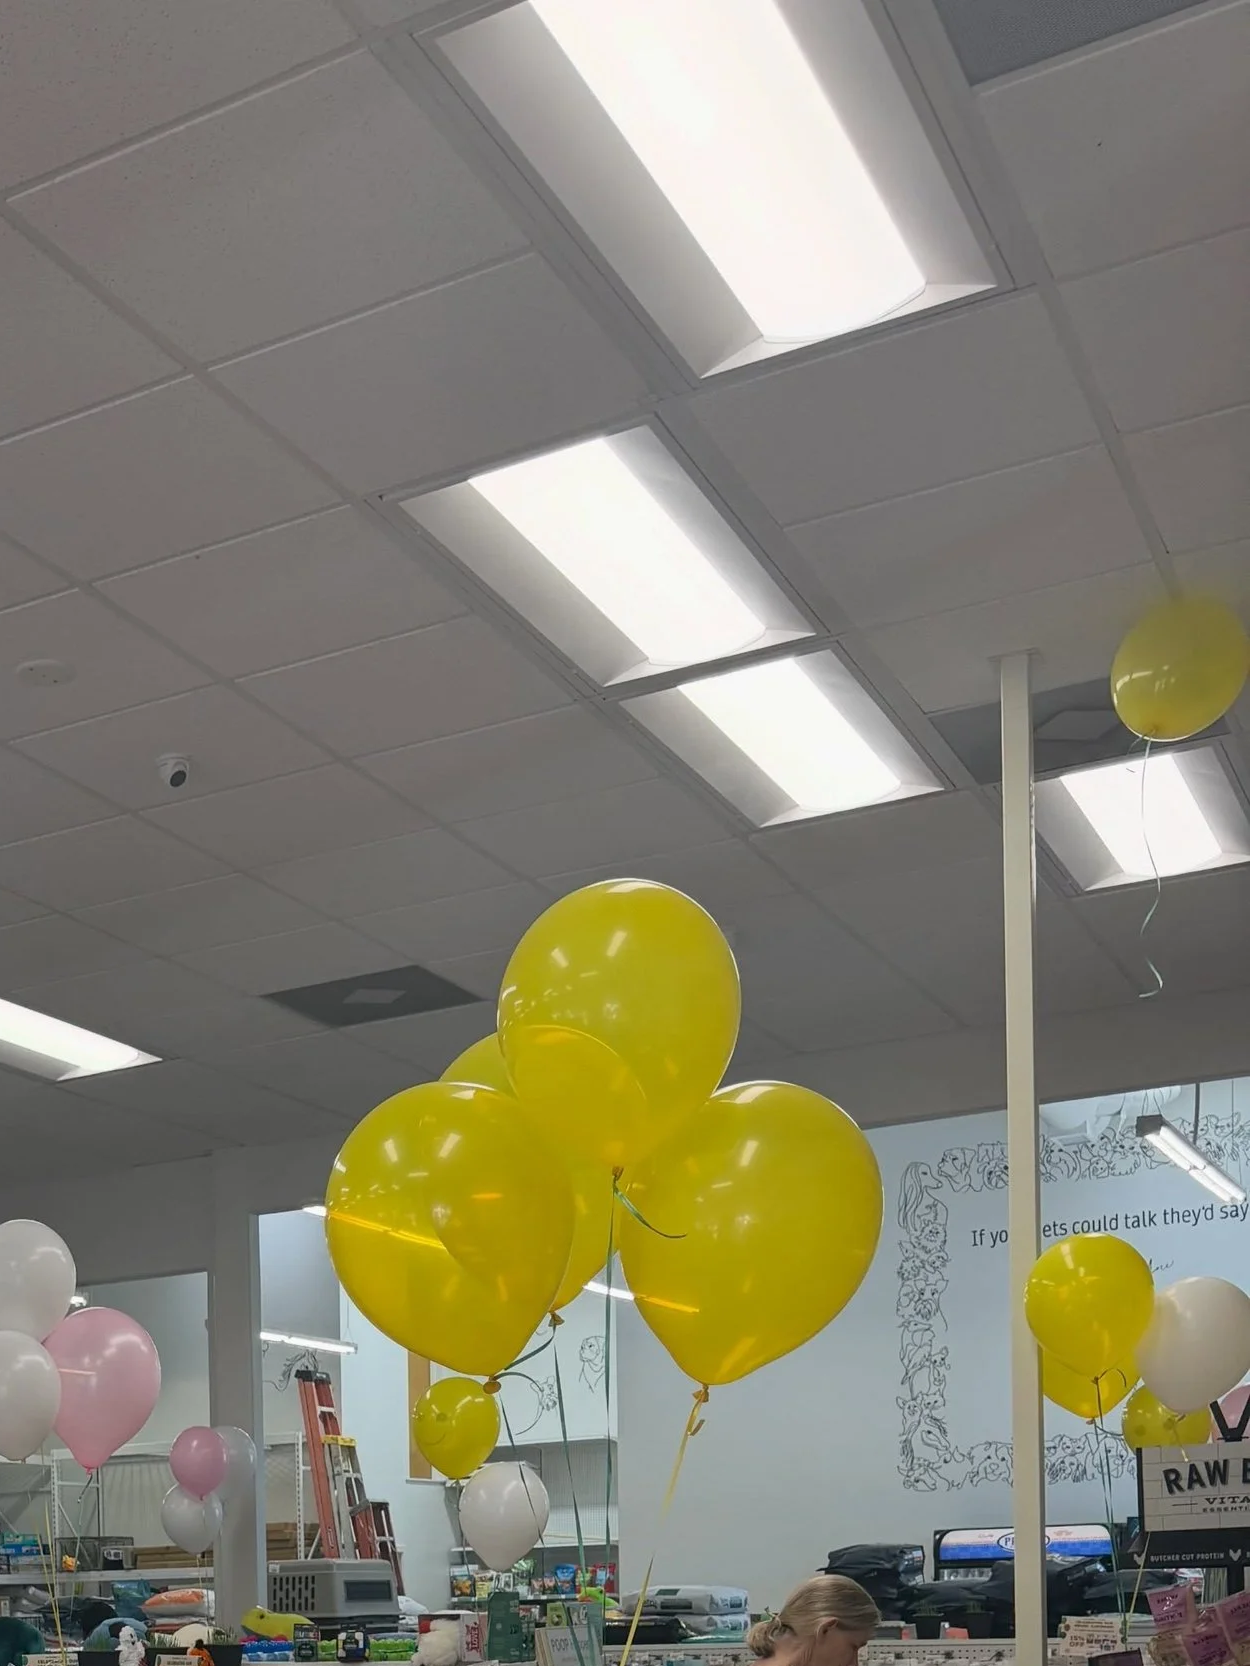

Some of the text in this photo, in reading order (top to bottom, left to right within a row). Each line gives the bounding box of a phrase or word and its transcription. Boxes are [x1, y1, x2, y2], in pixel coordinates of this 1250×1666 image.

[971, 1202, 1250, 1248] If yo ets could talk they'd say
[1163, 1458, 1229, 1495] RAW
[1204, 1496, 1250, 1505] VITA
[1150, 1551, 1225, 1563] BUTCHER CUT PROTEIN
[550, 1638, 568, 1653] POOP
